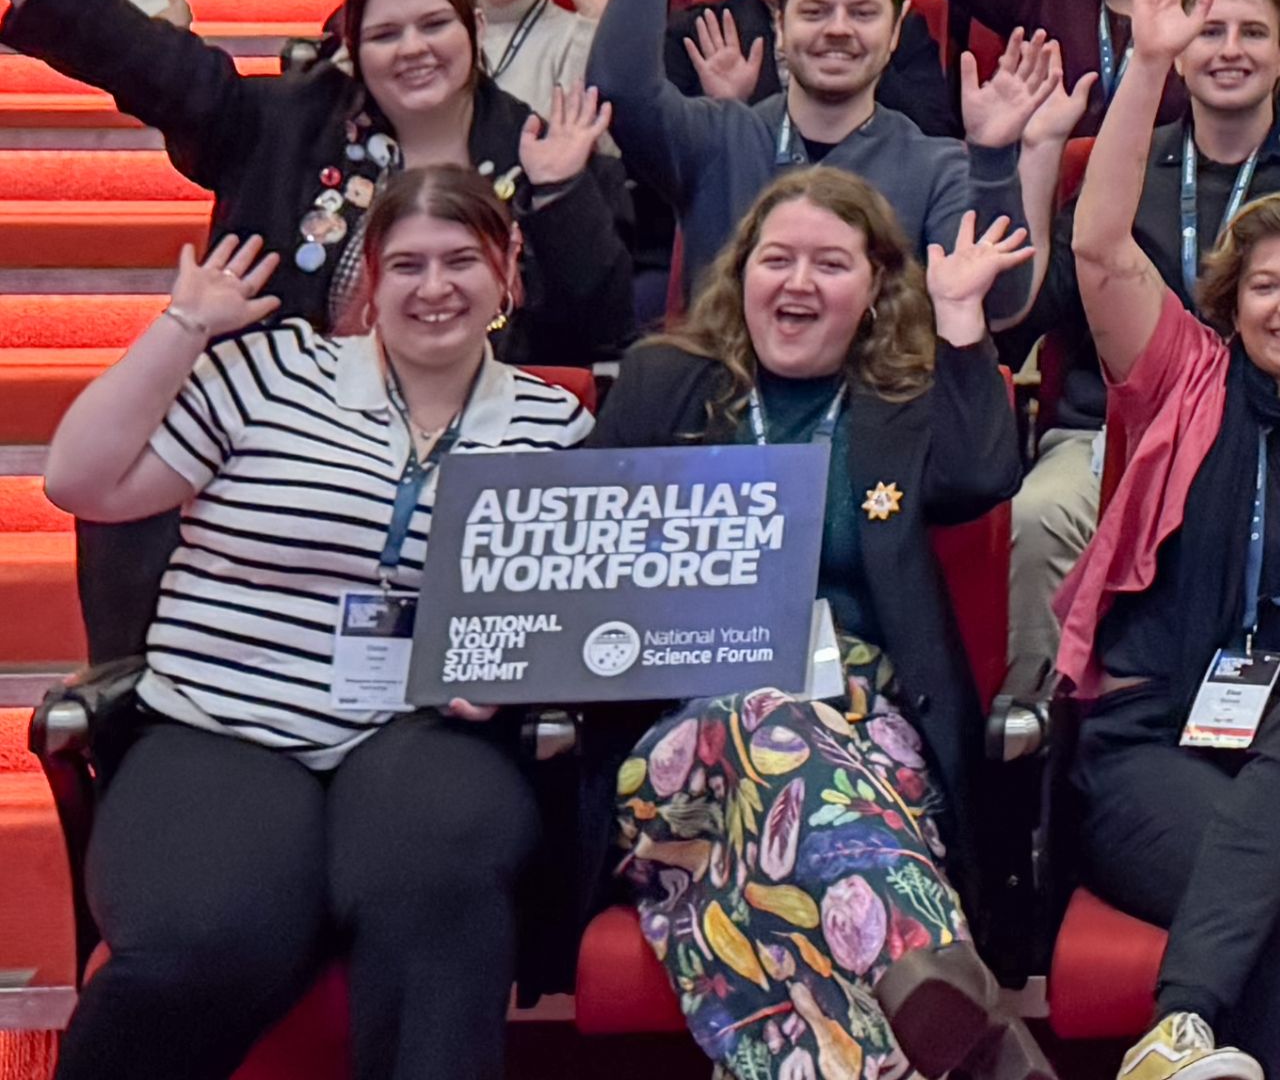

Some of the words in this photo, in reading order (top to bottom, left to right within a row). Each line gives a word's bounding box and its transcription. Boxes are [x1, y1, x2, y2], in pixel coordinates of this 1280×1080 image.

[466, 482, 777, 524] AUSTRALIA'S
[460, 520, 649, 558] FUTURE
[660, 515, 785, 553] STEM
[460, 550, 761, 593] WORKFORCE
[448, 614, 563, 634] NATIONAL
[449, 631, 526, 649] YOUTH
[643, 628, 716, 645] National
[720, 625, 771, 643] Youth
[444, 647, 503, 666] STEM
[641, 647, 713, 666] Science
[716, 647, 774, 663] Forum
[442, 661, 529, 683] SUMMIT
